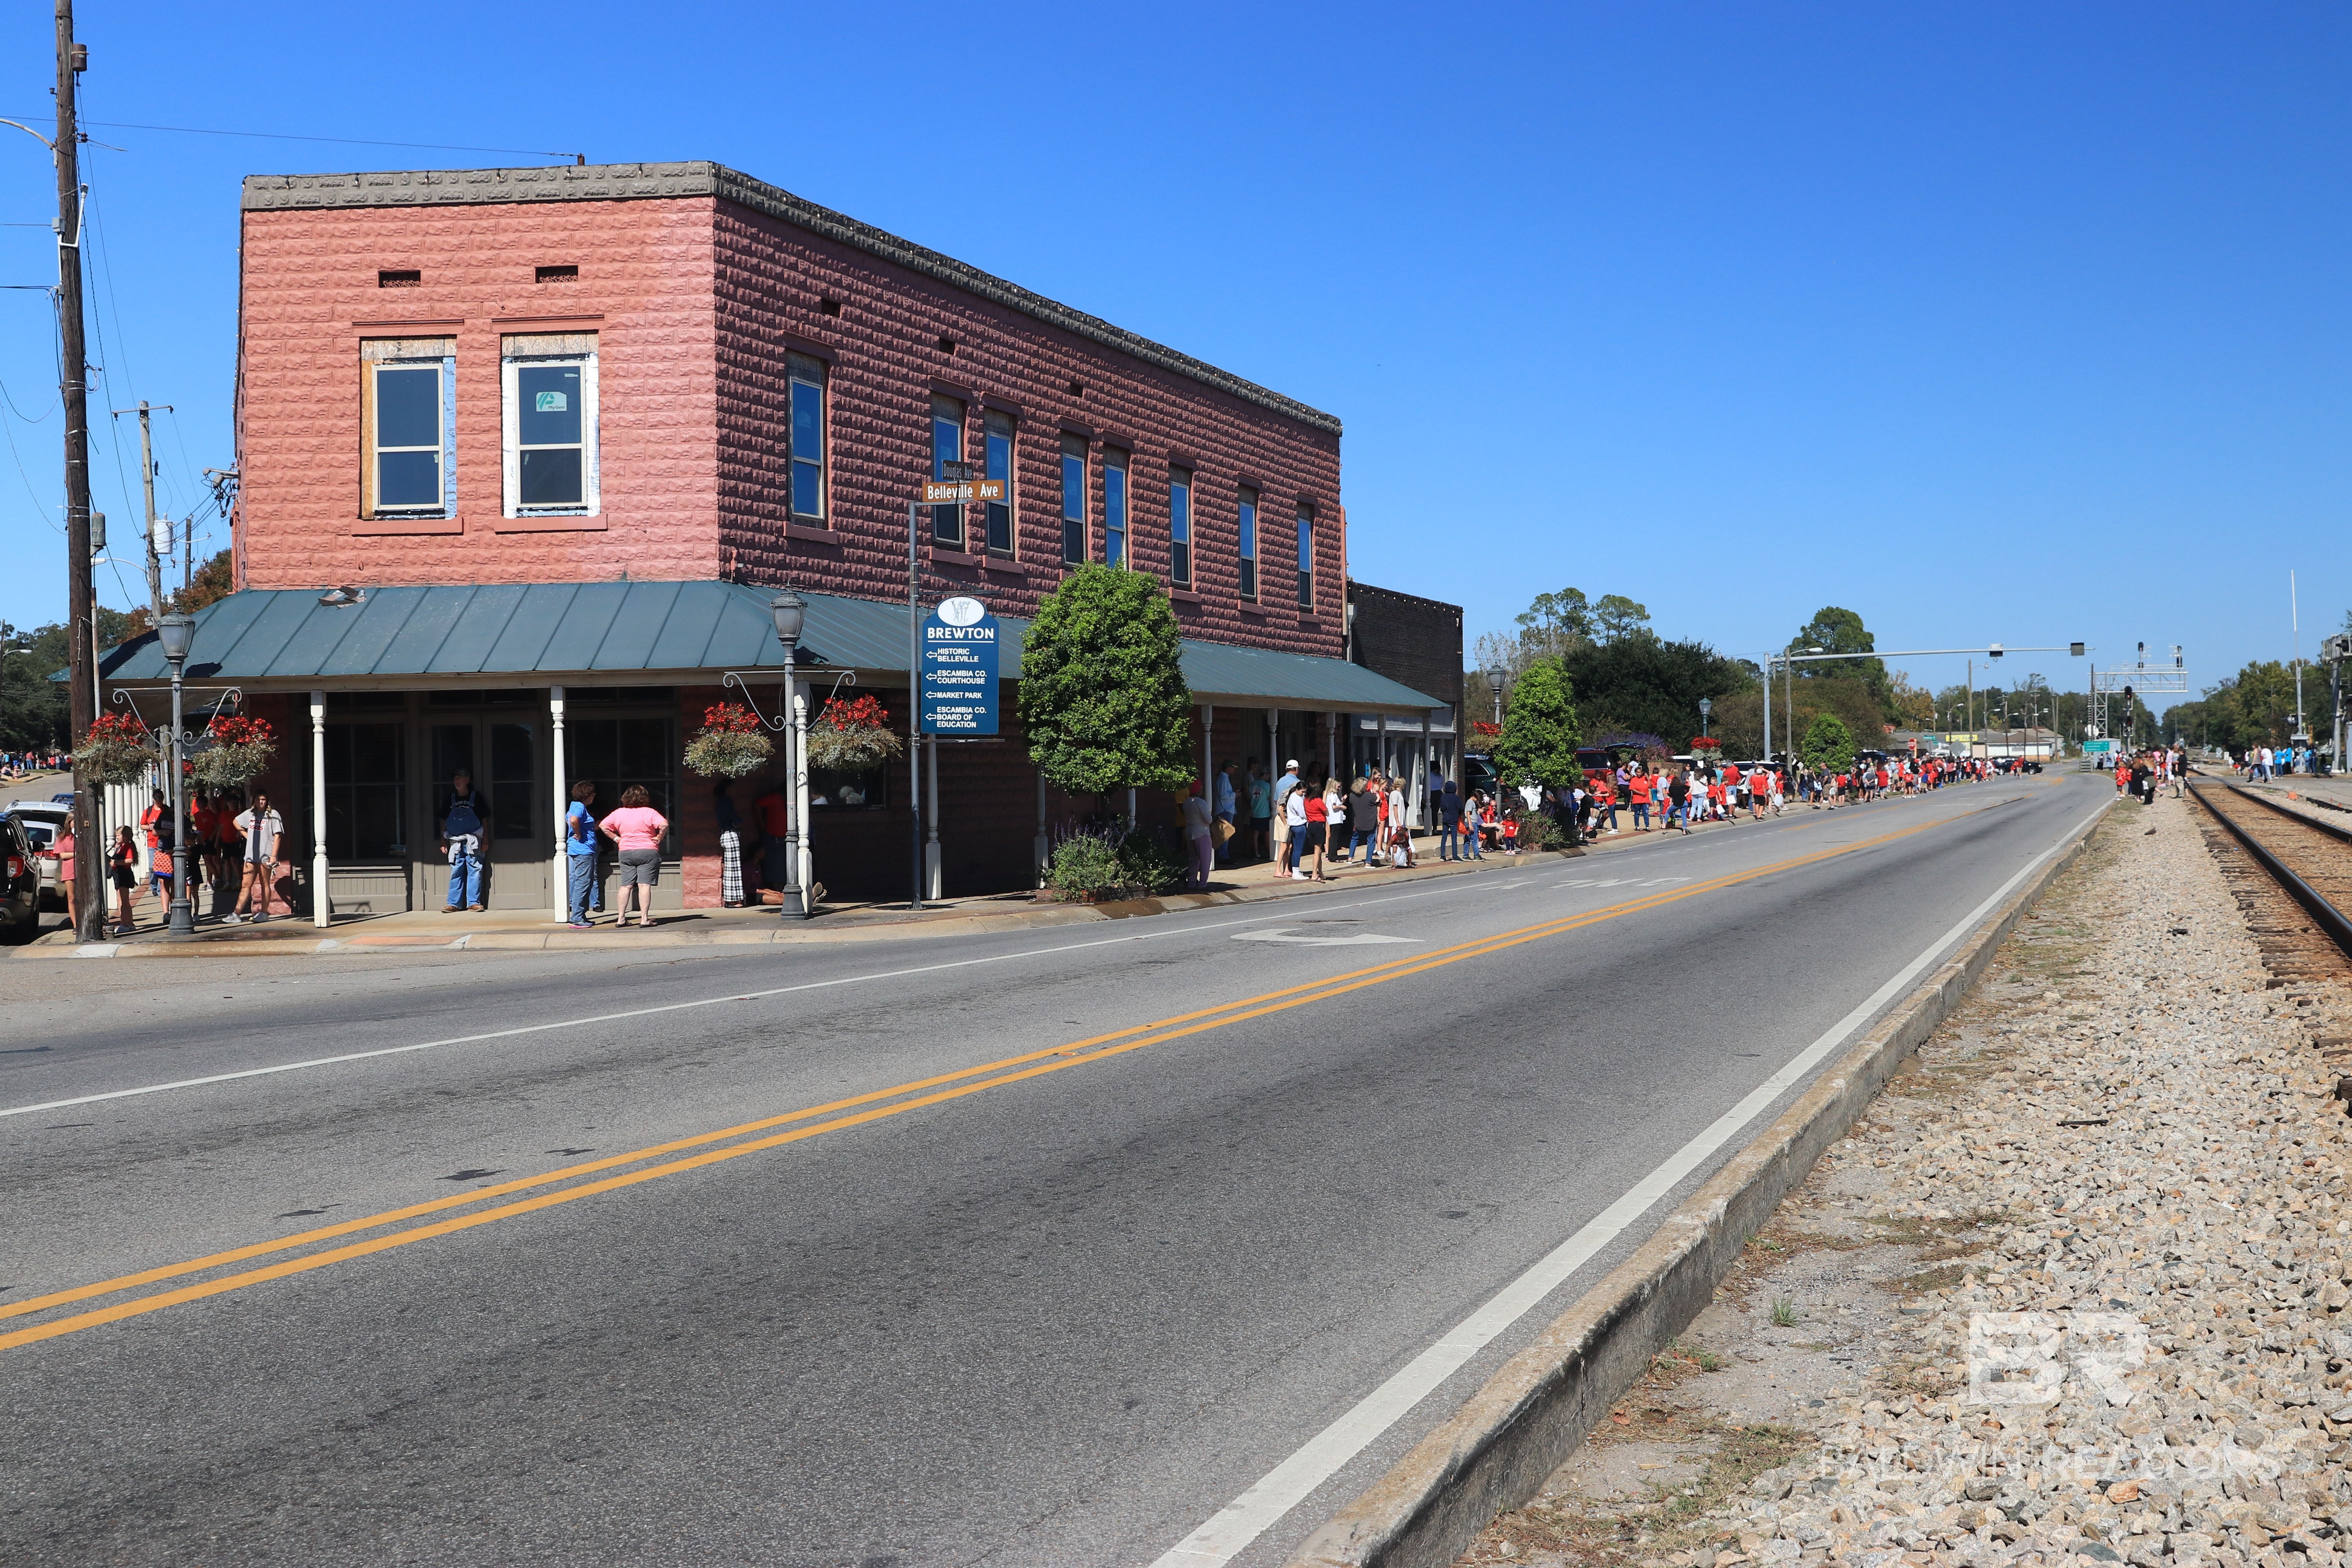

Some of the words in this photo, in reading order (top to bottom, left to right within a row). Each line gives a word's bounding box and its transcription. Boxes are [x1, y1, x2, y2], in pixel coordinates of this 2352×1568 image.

[944, 463, 962, 481] Douglas
[927, 484, 973, 499] Belleville
[980, 483, 998, 497] Ave
[927, 627, 994, 639] BREWTON
